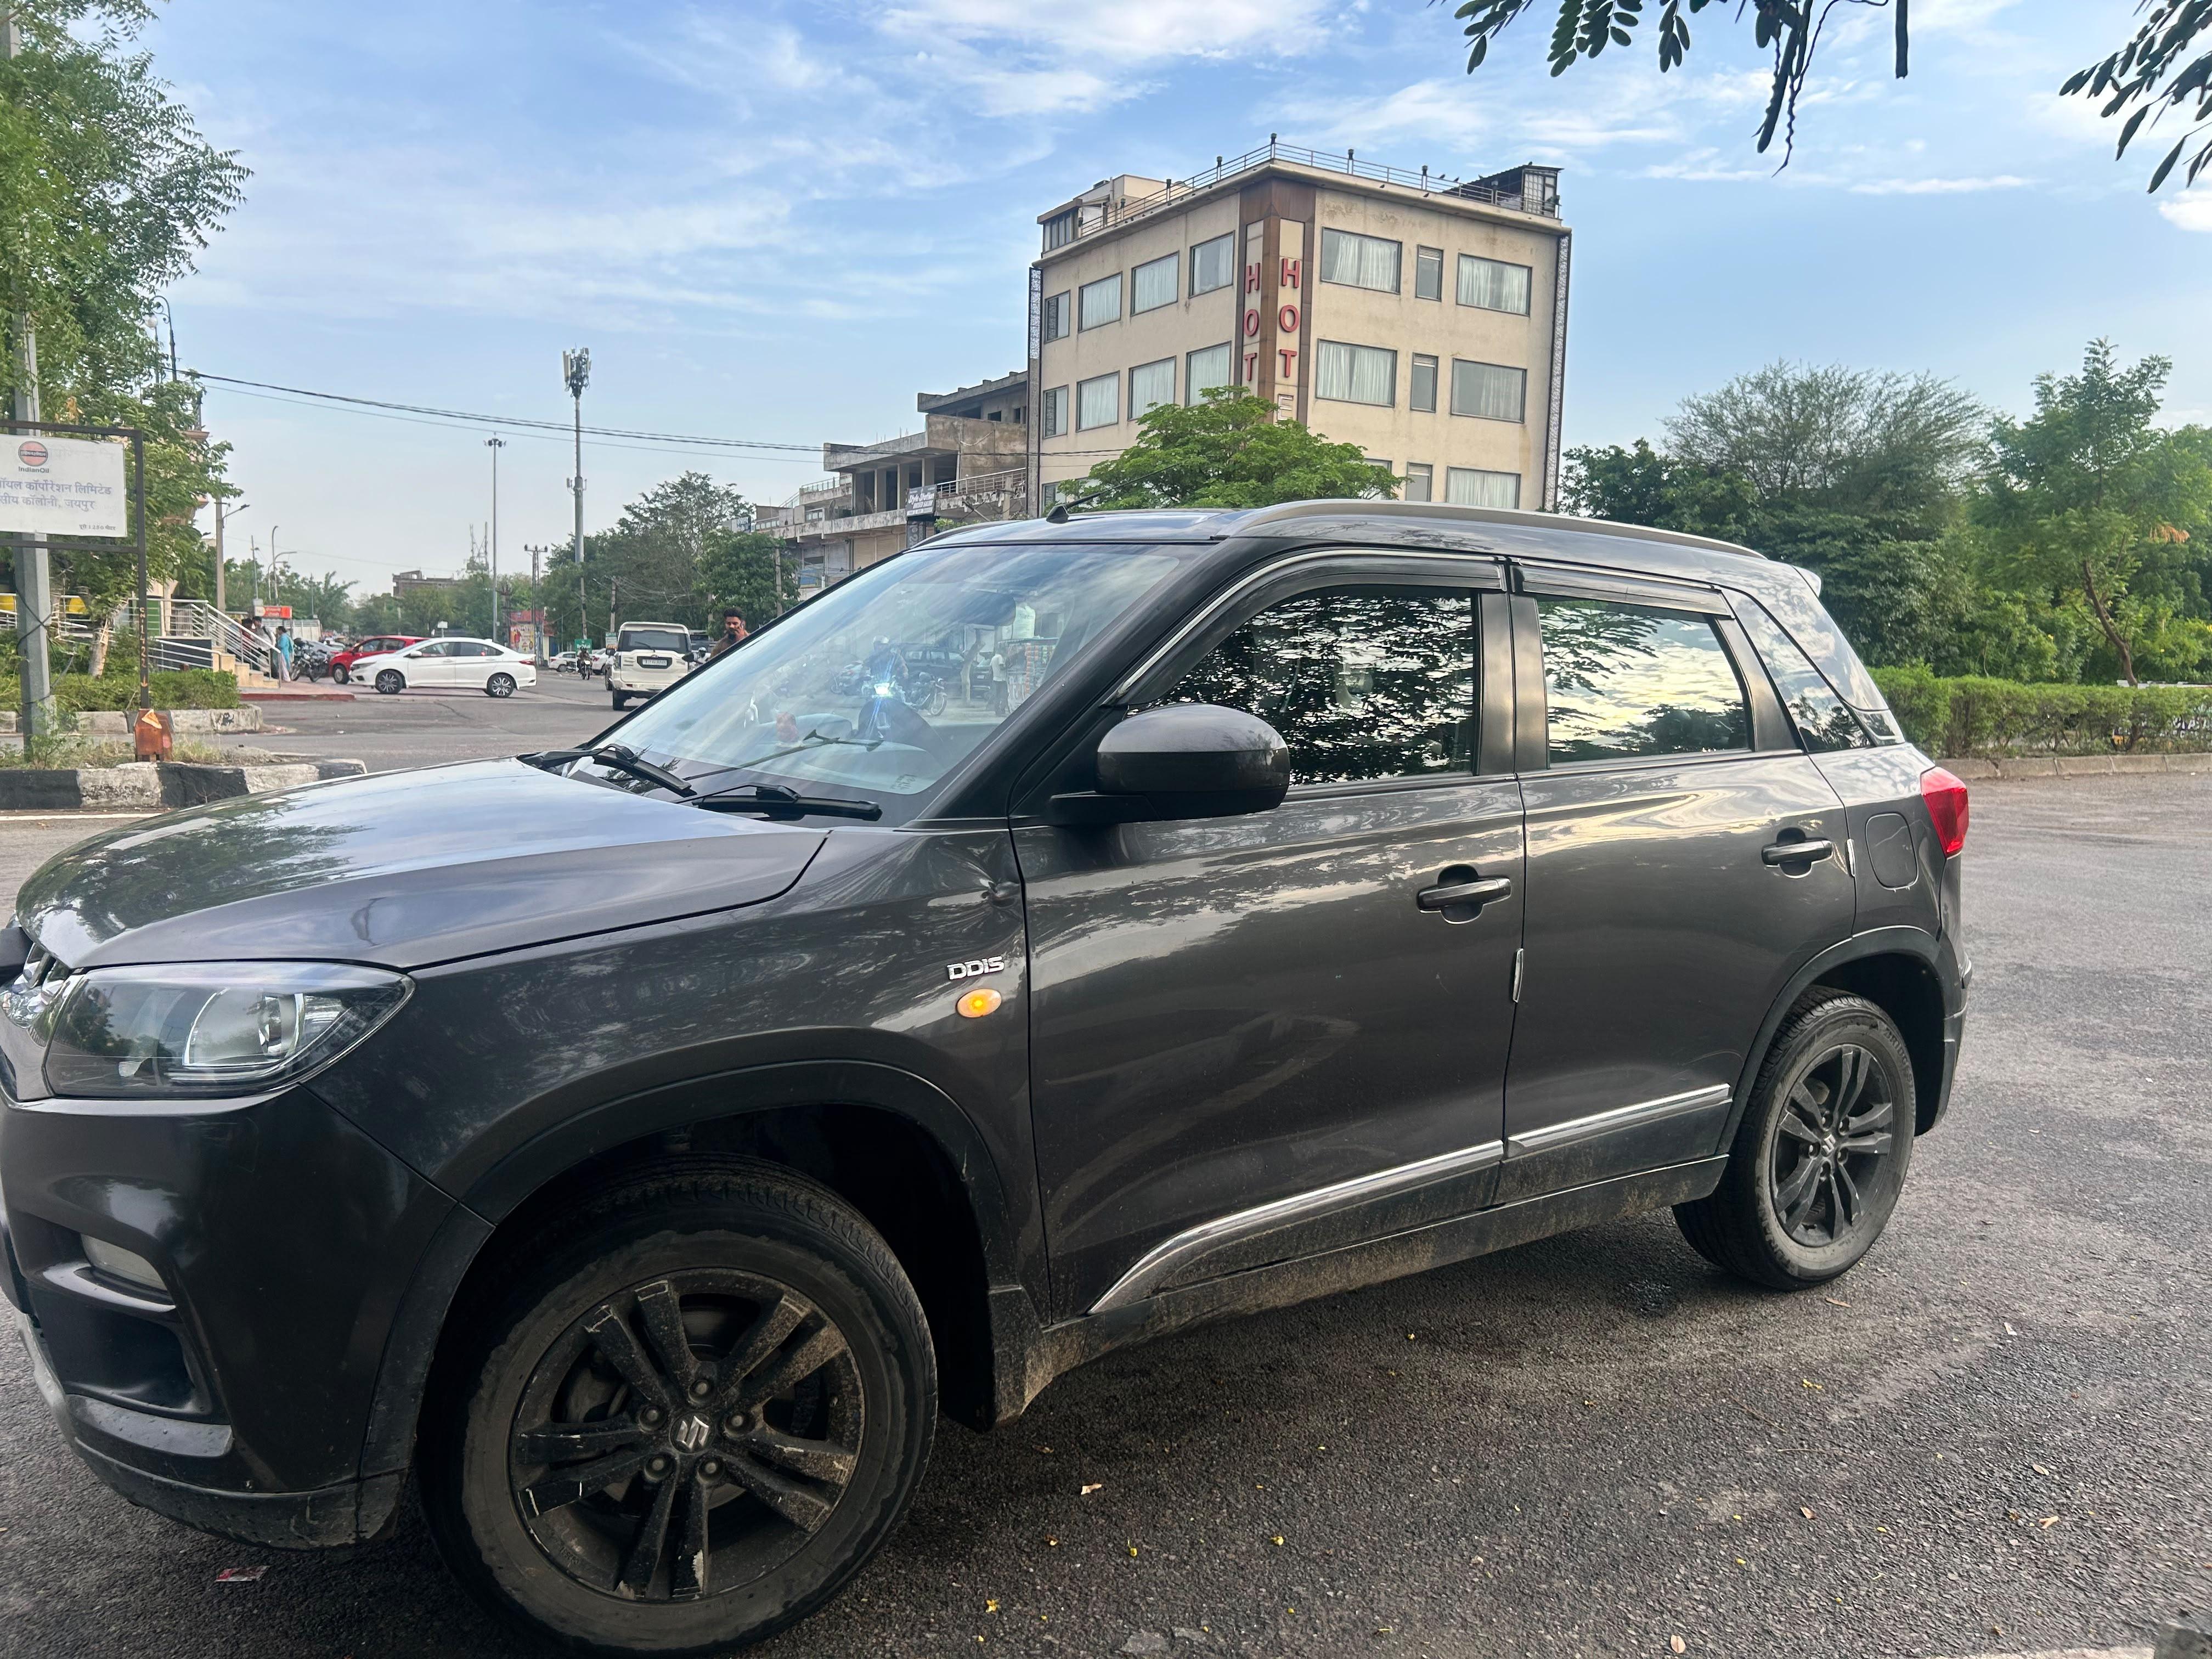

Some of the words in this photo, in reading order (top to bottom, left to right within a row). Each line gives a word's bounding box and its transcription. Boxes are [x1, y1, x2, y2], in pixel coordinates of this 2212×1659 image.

[24, 479, 72, 493] कॉर्पोरेशन
[74, 482, 112, 494] लिमिटेड
[64, 498, 95, 512] जयपुर
